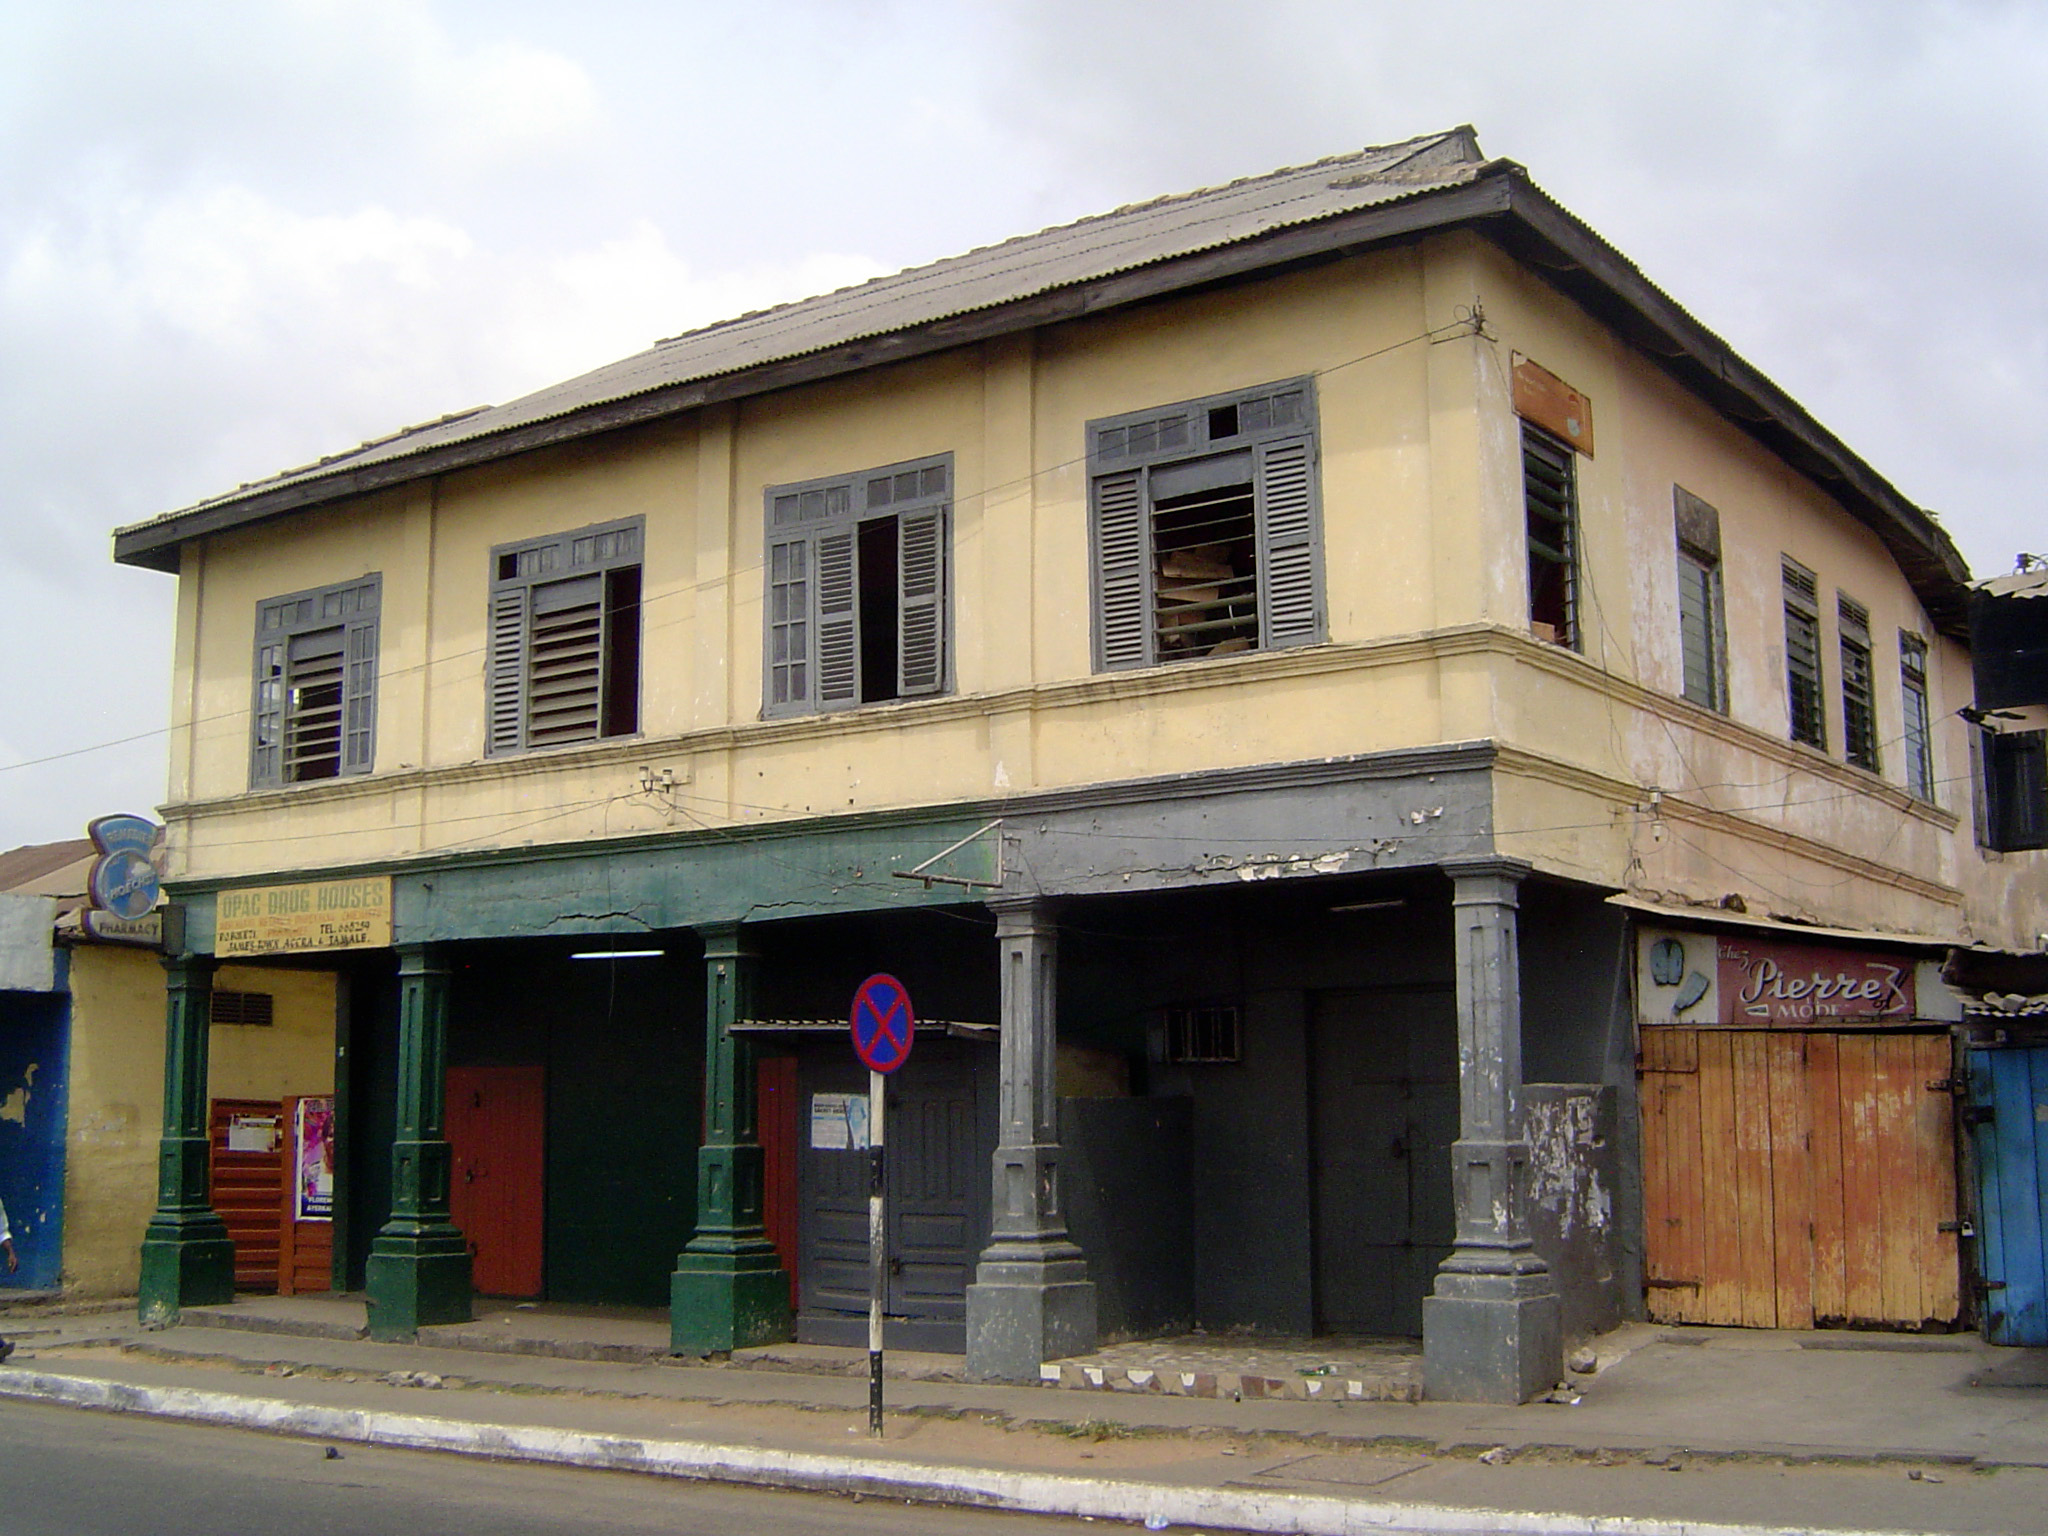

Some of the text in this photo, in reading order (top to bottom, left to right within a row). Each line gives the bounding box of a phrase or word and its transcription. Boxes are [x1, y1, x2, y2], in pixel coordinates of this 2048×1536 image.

[222, 882, 383, 919] OPAC DRUG HOUSES
[99, 922, 158, 936] PHARMACY
[1739, 957, 1883, 1004] Pierre
